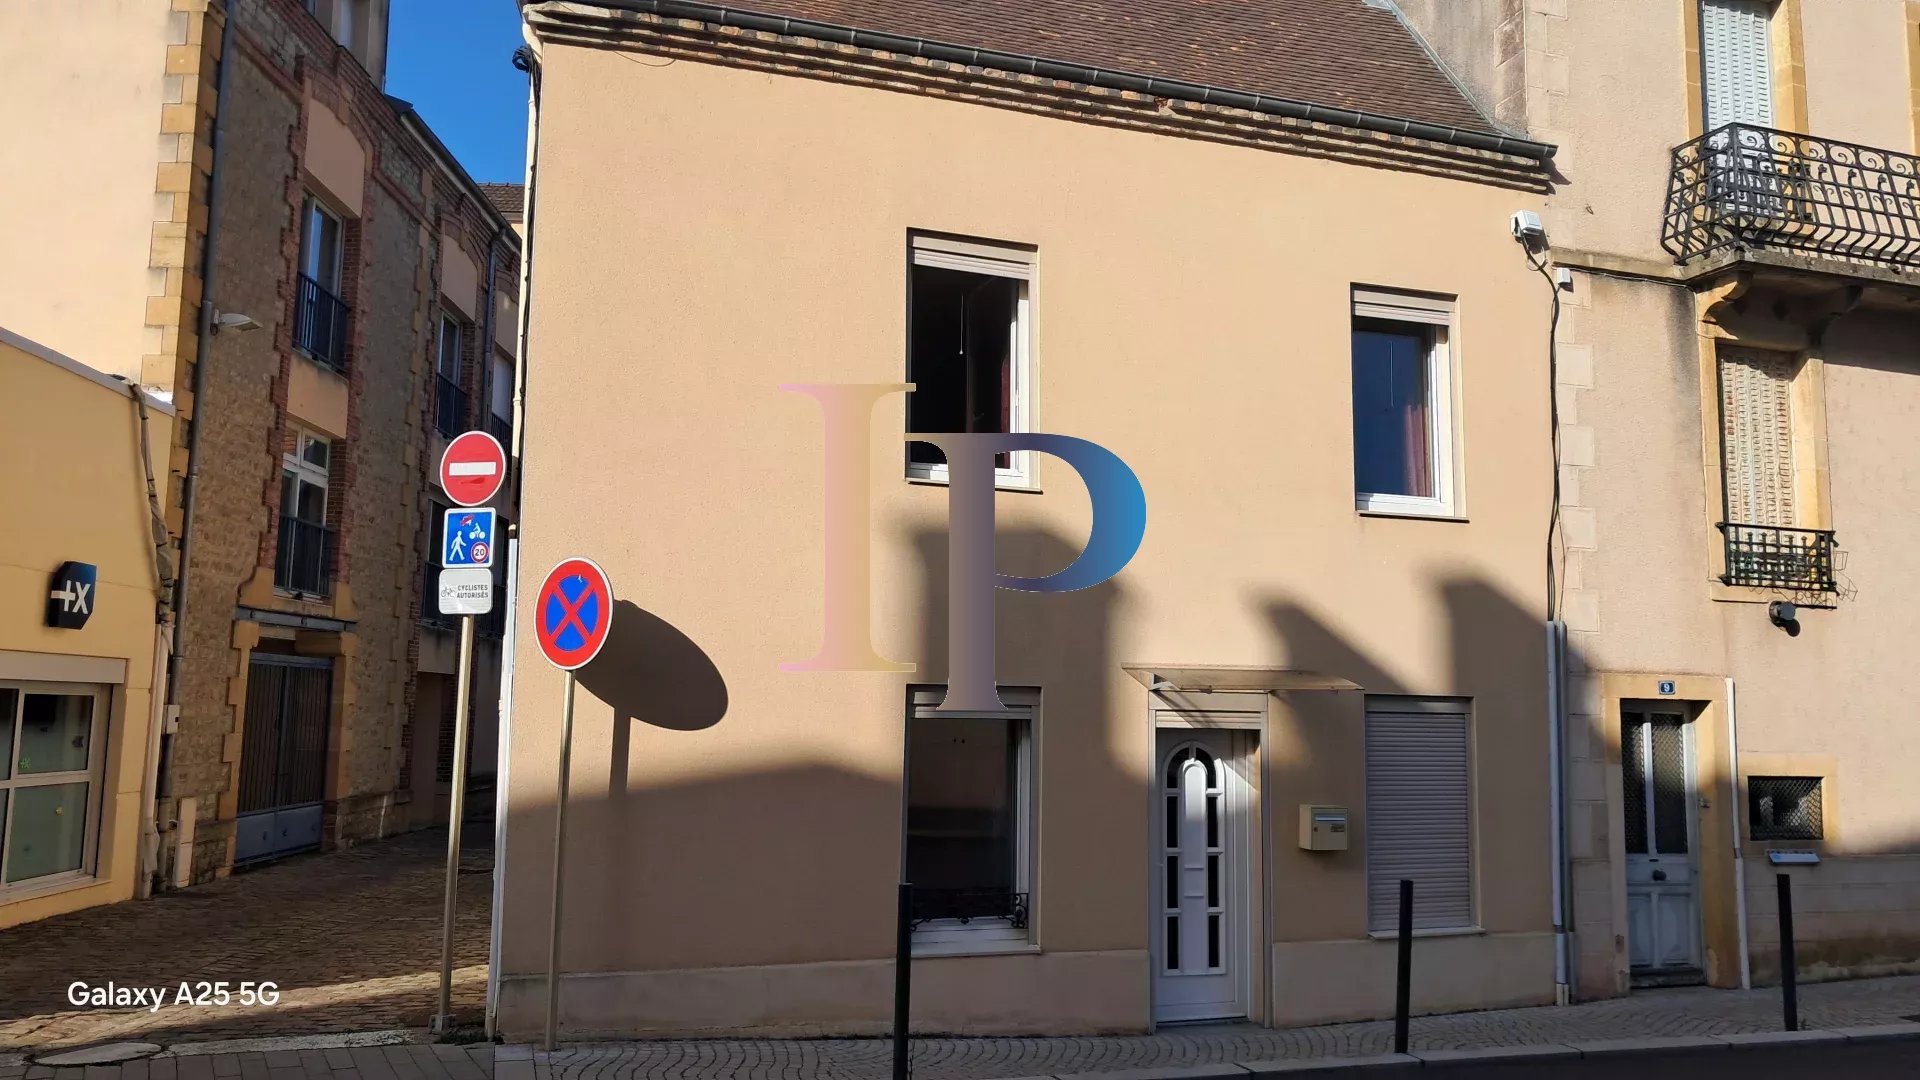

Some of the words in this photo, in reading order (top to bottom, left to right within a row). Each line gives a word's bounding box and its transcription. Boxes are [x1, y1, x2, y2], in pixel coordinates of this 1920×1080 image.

[475, 548, 485, 557] 20
[456, 591, 489, 599] AUTORISÉS
[1663, 683, 1670, 692] 9
